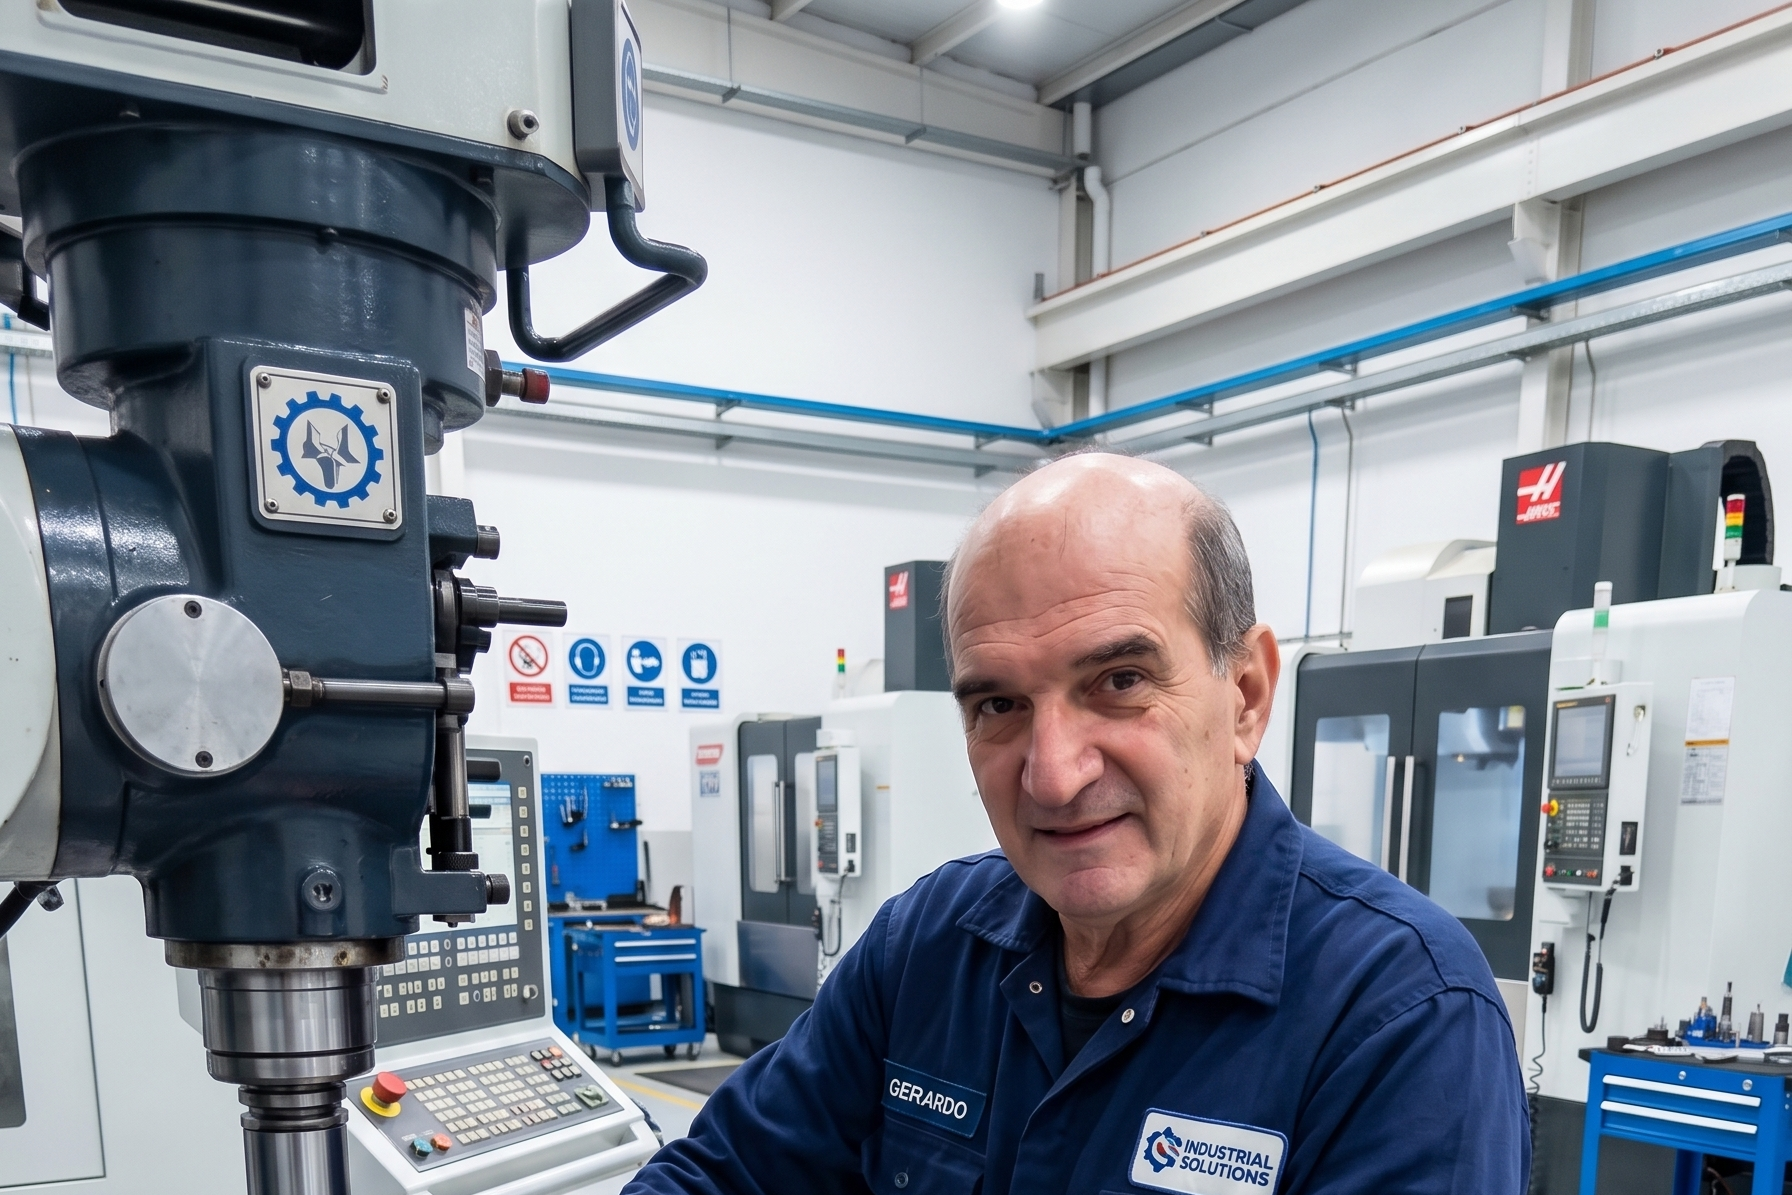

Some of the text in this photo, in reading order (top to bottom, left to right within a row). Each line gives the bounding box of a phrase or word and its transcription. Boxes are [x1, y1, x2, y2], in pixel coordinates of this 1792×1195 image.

[889, 1078, 968, 1120] GERARDO
[1184, 1139, 1274, 1170] INDUSTRIAL
[1179, 1155, 1270, 1187] SOLUTIONS
